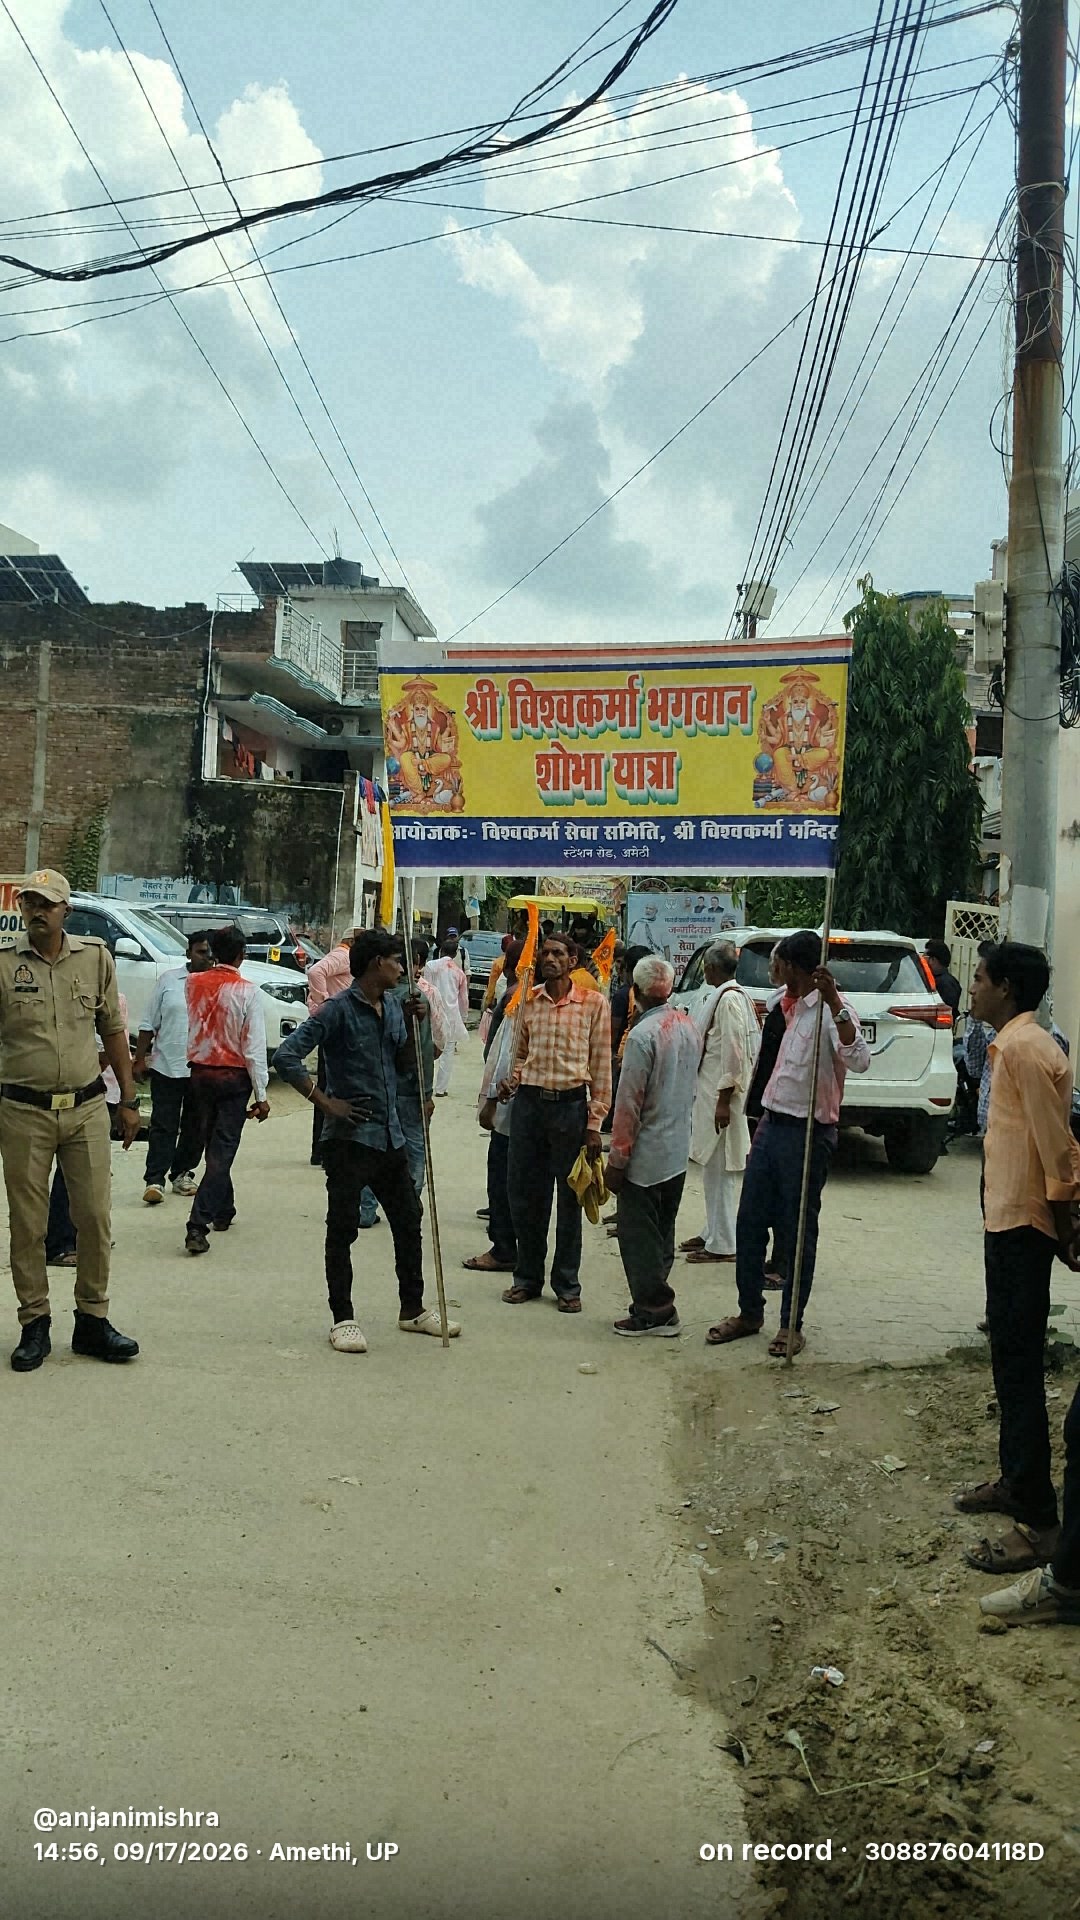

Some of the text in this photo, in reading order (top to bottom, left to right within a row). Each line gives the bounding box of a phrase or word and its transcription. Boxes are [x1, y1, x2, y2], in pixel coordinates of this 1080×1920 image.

[464, 673, 755, 735] श्री विश्वकर्मा भगवान
[535, 740, 680, 798] शोभा यात्रा
[482, 821, 560, 841] विश्वकर्मा
[564, 821, 598, 841] सेवा
[603, 820, 666, 842] समिति,
[673, 820, 696, 840] श्री
[700, 818, 784, 840] विश्वकर्मा
[789, 819, 838, 840] मन्दिर
[563, 845, 650, 859] स्टेशन रोड, अमेठी
[139, 890, 161, 900] कोमल
[143, 880, 162, 891] बेहतर
